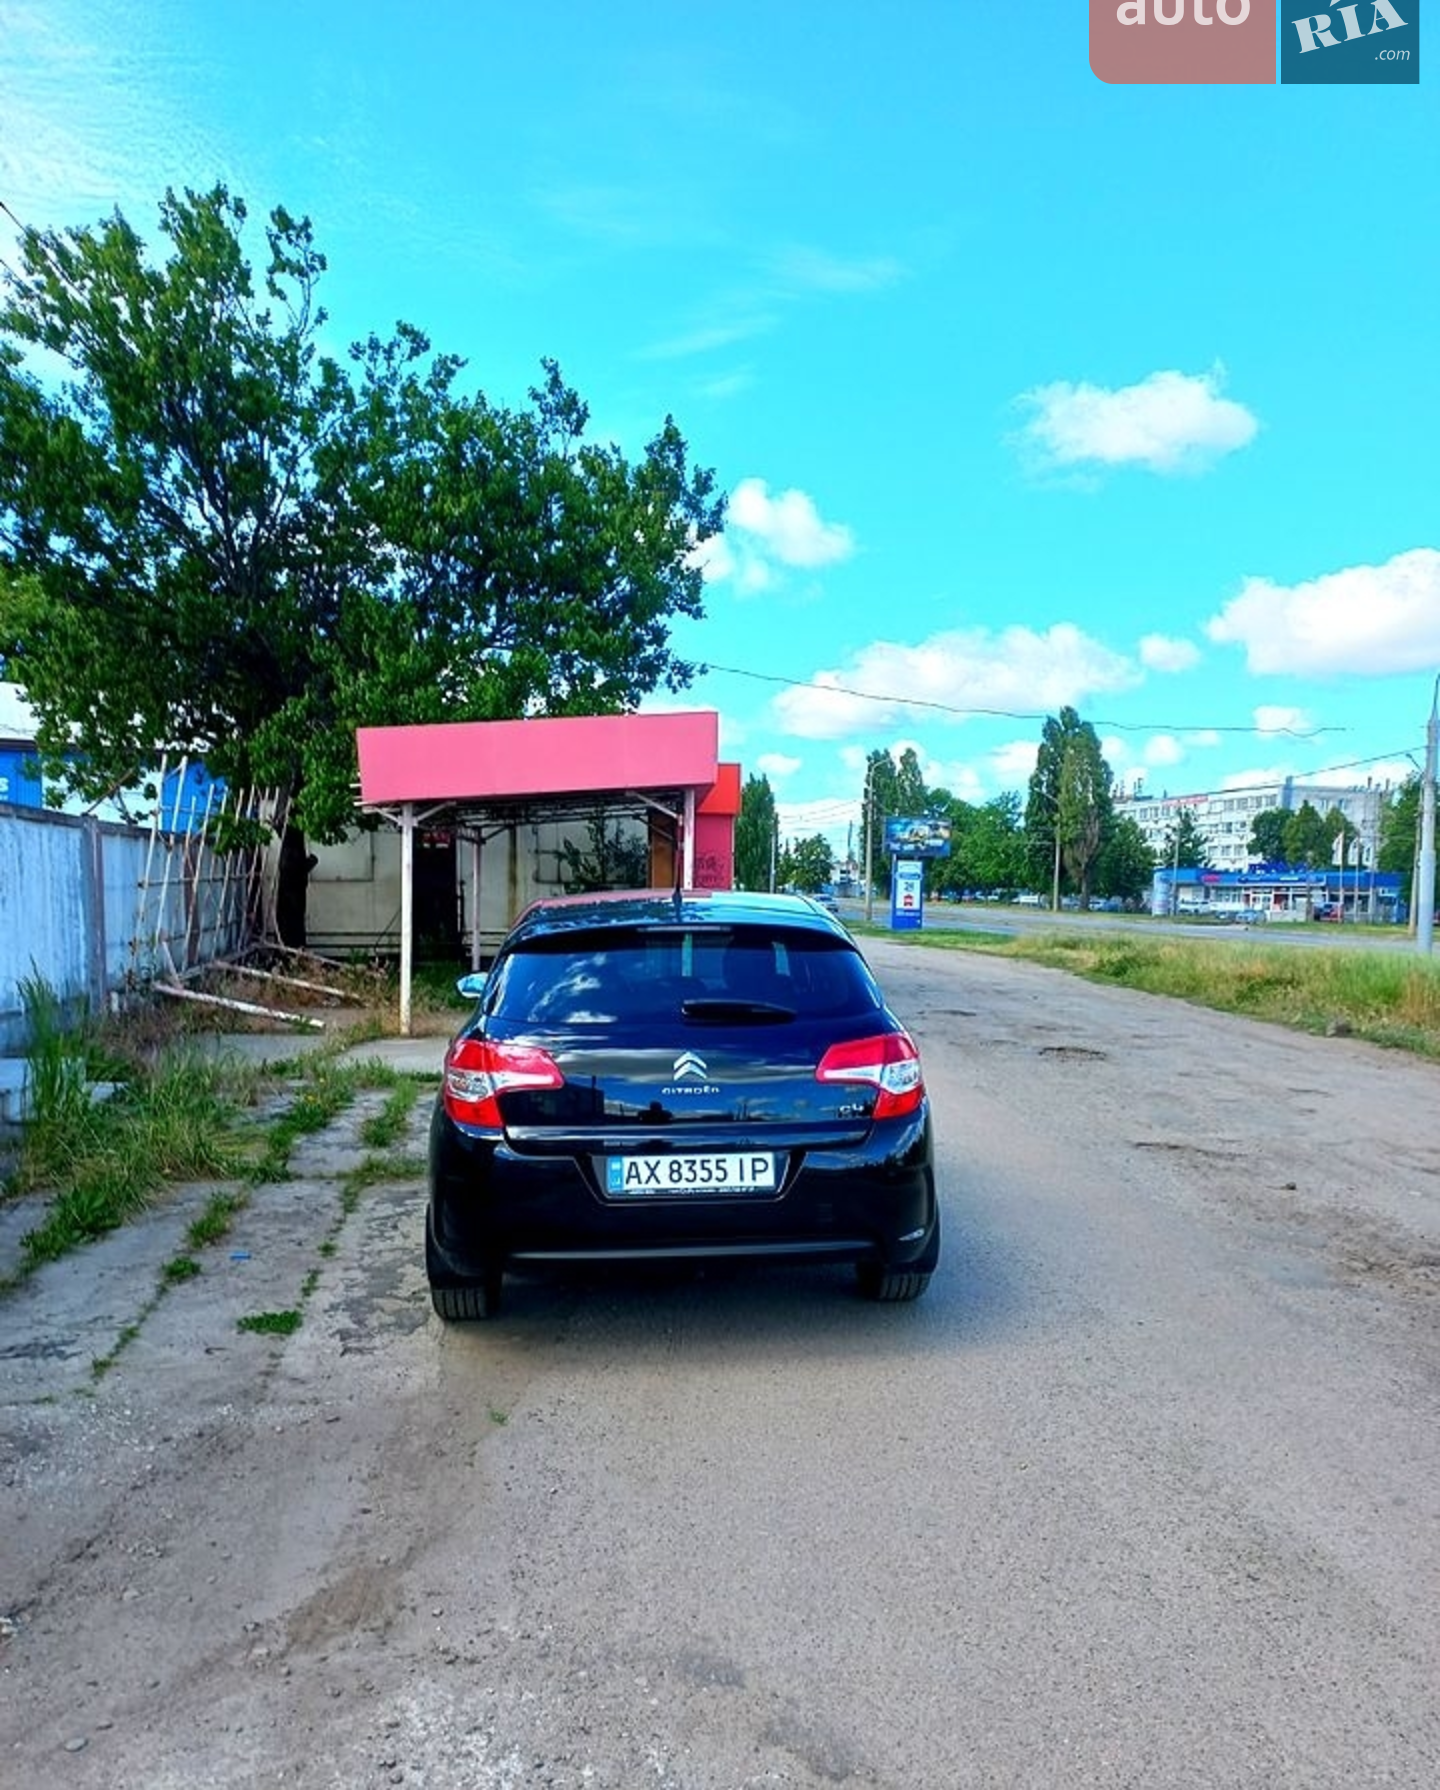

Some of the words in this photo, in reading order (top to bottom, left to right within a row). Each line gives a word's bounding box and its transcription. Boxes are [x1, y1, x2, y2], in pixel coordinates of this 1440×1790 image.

[625, 1160, 662, 1185] AX
[668, 1158, 729, 1184] 8355
[739, 1157, 769, 1182] IP
